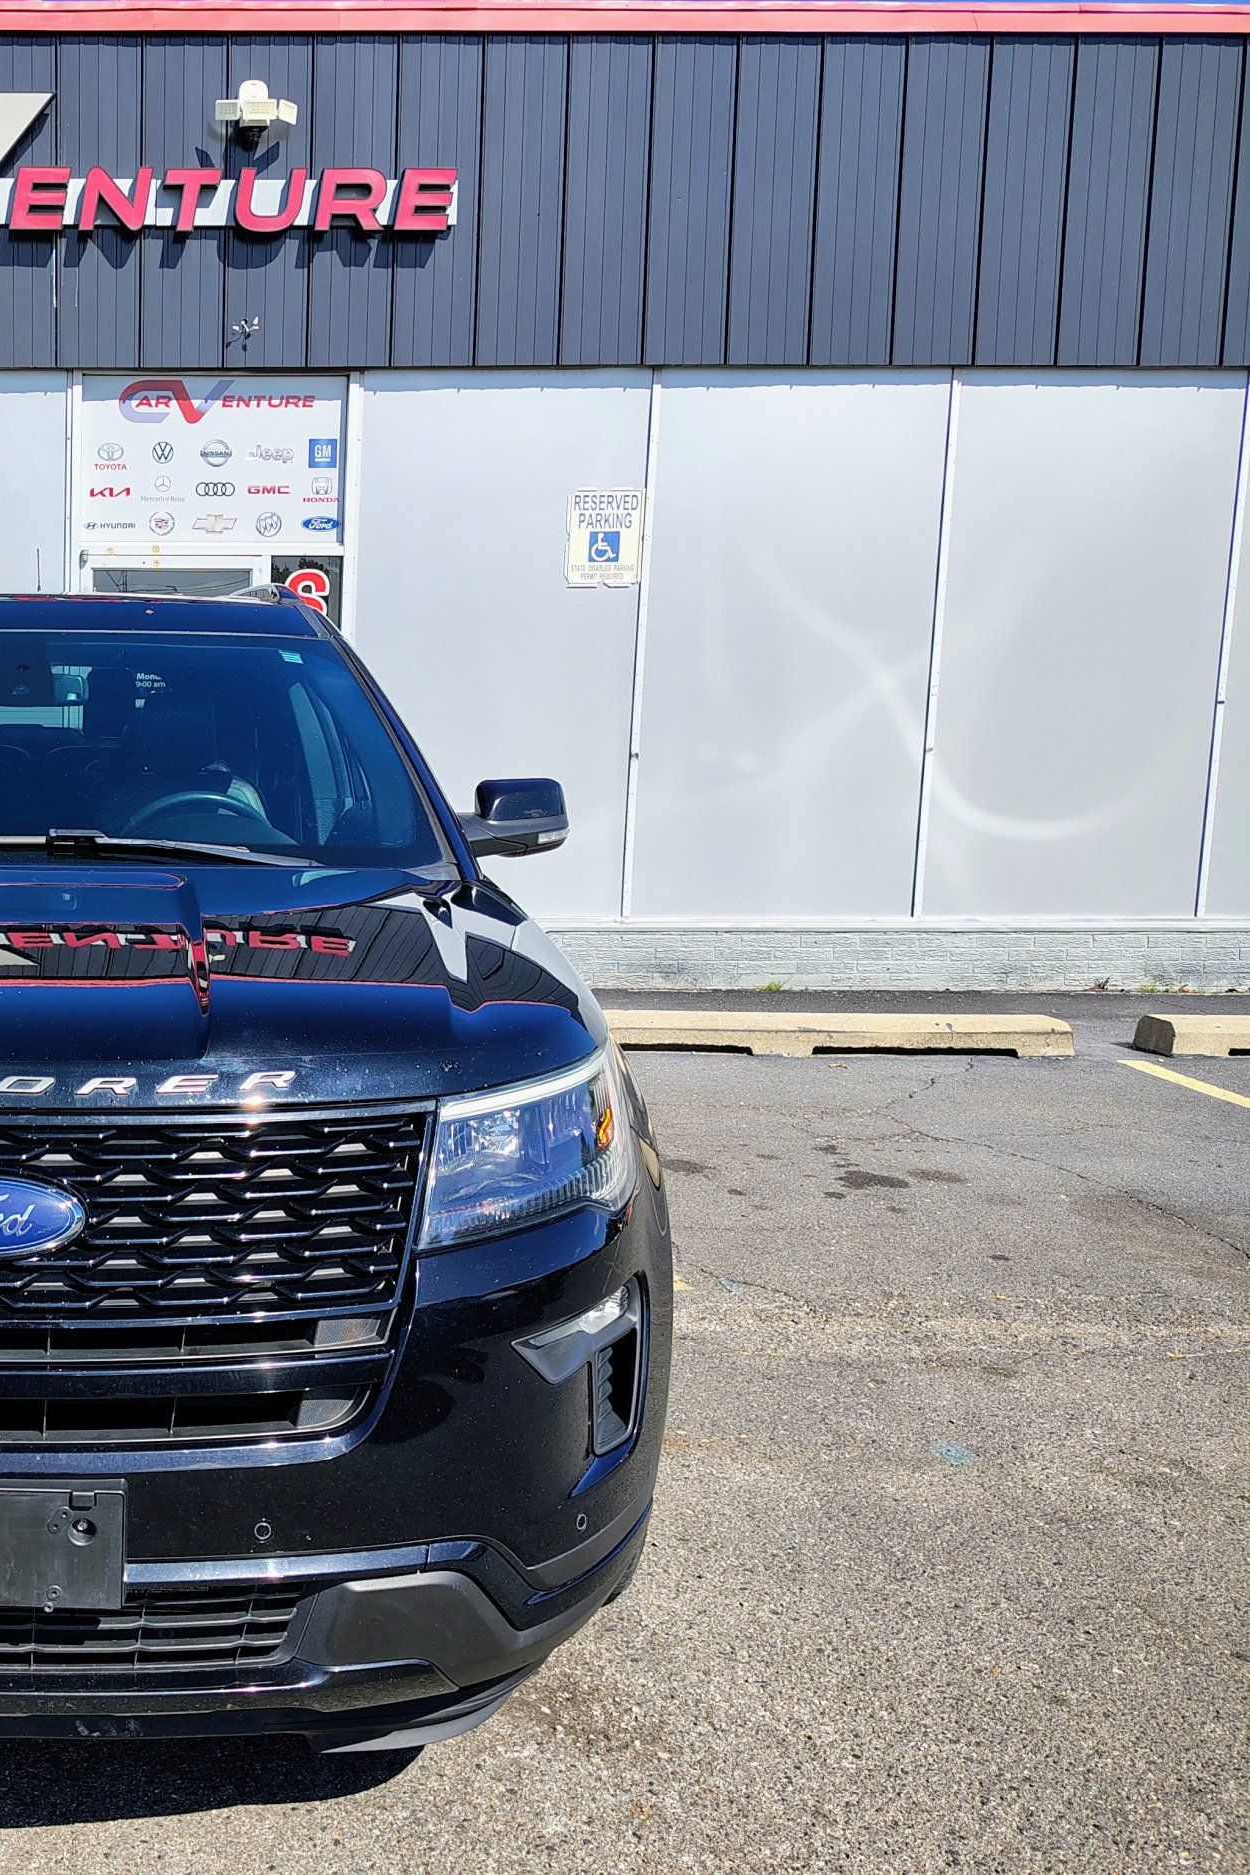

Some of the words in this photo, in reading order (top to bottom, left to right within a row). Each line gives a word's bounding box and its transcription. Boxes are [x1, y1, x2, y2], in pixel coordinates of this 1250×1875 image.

[248, 444, 294, 464] Jeep
[314, 444, 332, 458] GM
[94, 463, 127, 471] TOYOTA
[247, 485, 291, 495] GMC
[573, 494, 639, 511] RESERVED
[308, 518, 334, 529] Ford
[578, 513, 633, 529] PARKING
[135, 680, 152, 688] 9:00
